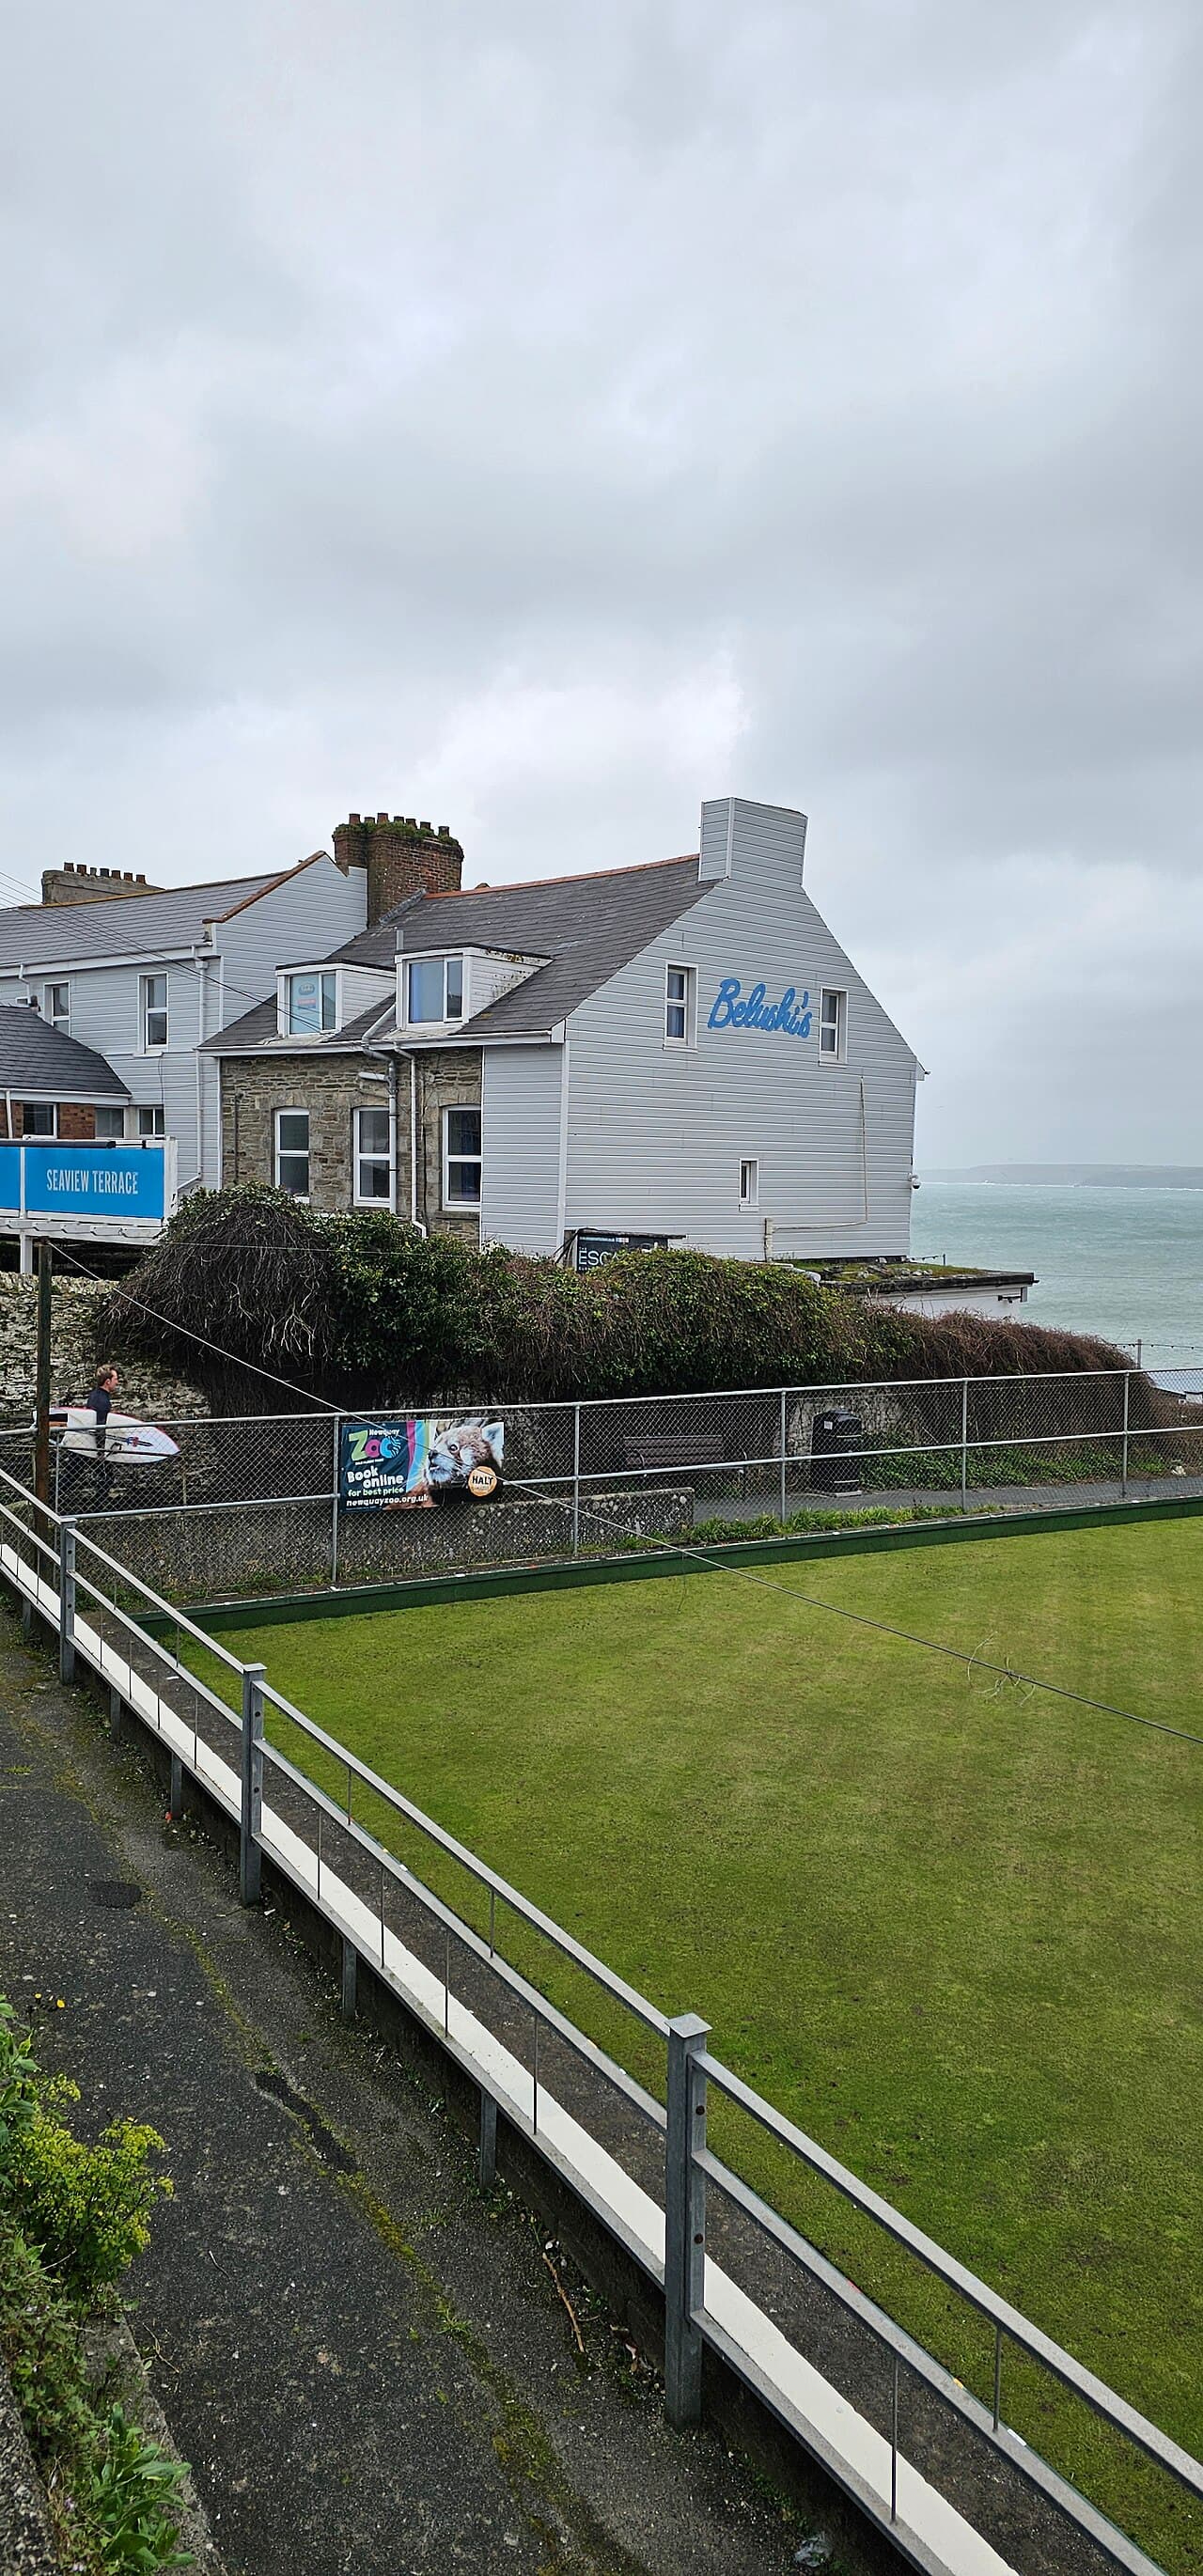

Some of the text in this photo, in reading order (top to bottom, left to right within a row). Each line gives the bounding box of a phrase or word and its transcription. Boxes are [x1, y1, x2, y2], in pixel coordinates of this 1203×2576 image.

[708, 977, 813, 1038] Belushi's
[46, 1168, 138, 1194] SEAVIEW TERRACE
[347, 1466, 378, 1483] Book
[363, 1475, 404, 1489] online
[347, 1487, 404, 1497] for best price
[346, 1494, 429, 1507] newquayzoo.org.uk
